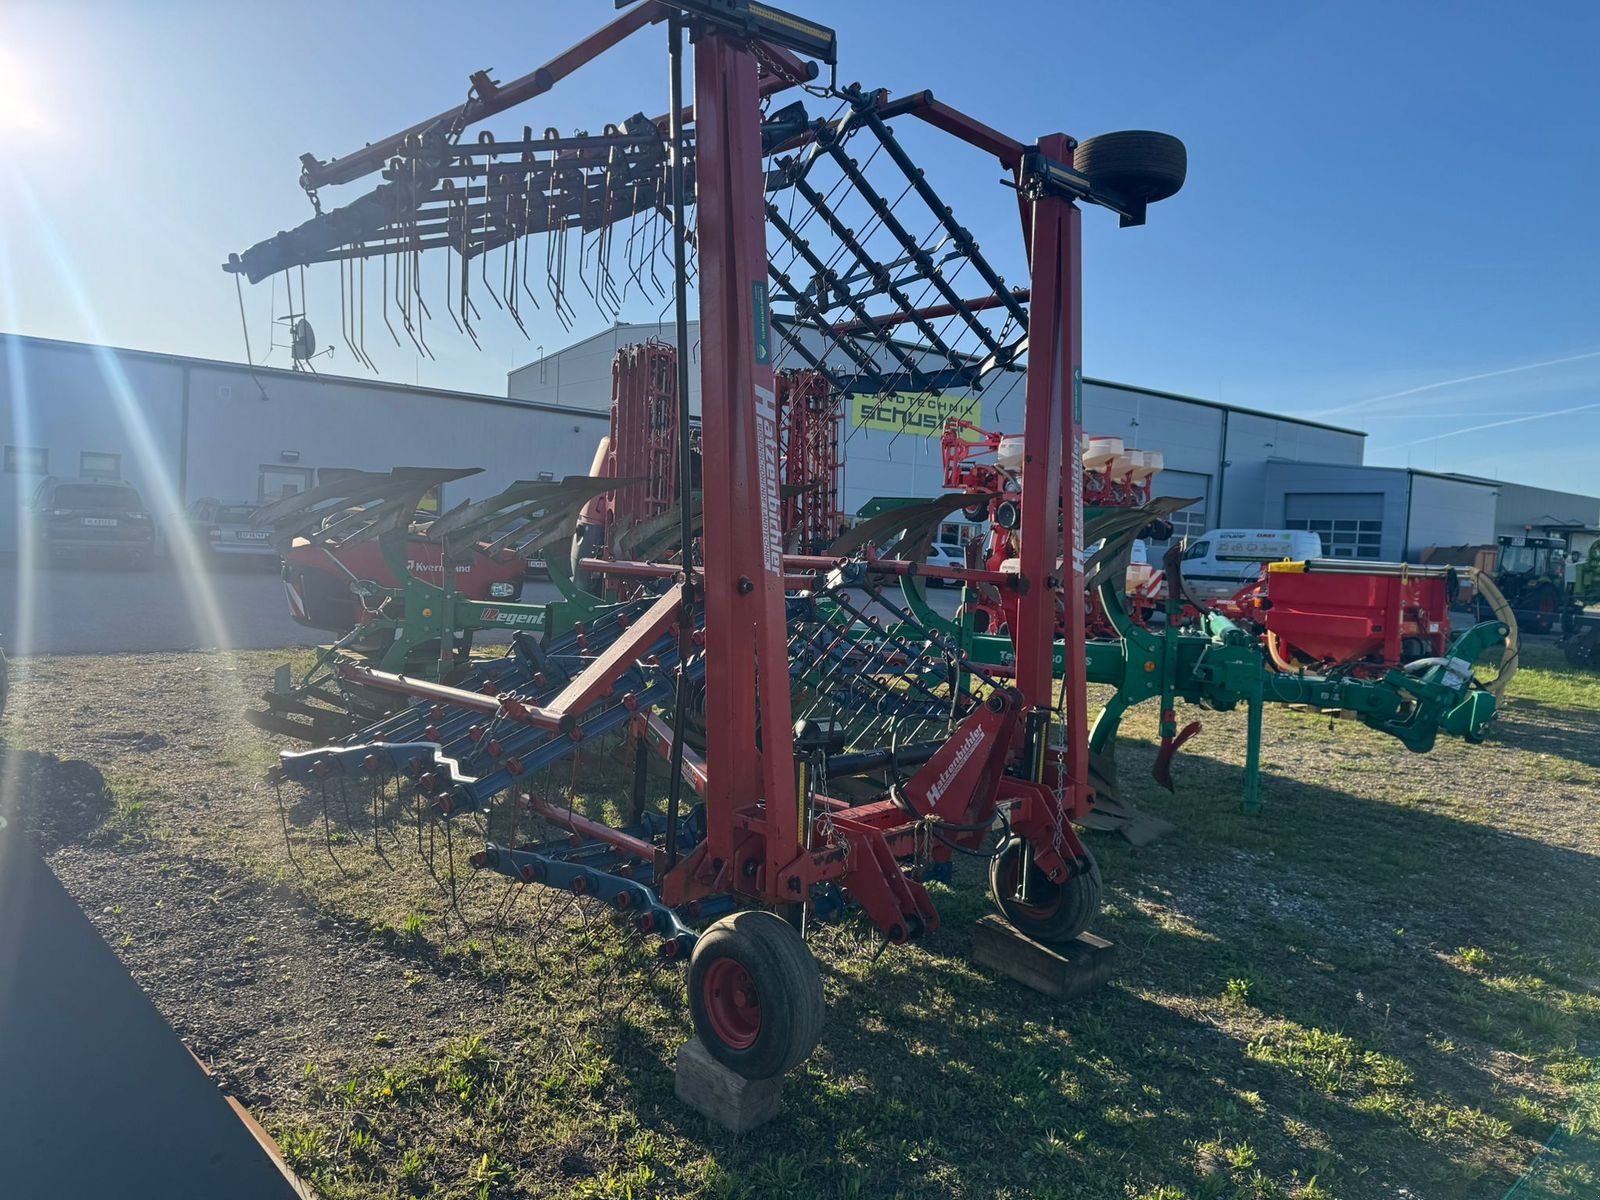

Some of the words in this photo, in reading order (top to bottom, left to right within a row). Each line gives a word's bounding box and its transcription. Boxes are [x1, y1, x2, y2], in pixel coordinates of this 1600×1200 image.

[754, 384, 783, 577] Hatzenbichler
[1071, 434, 1085, 574] Hatzenbichler
[480, 608, 546, 625] Regent
[926, 723, 983, 807] Hatzenbichler
